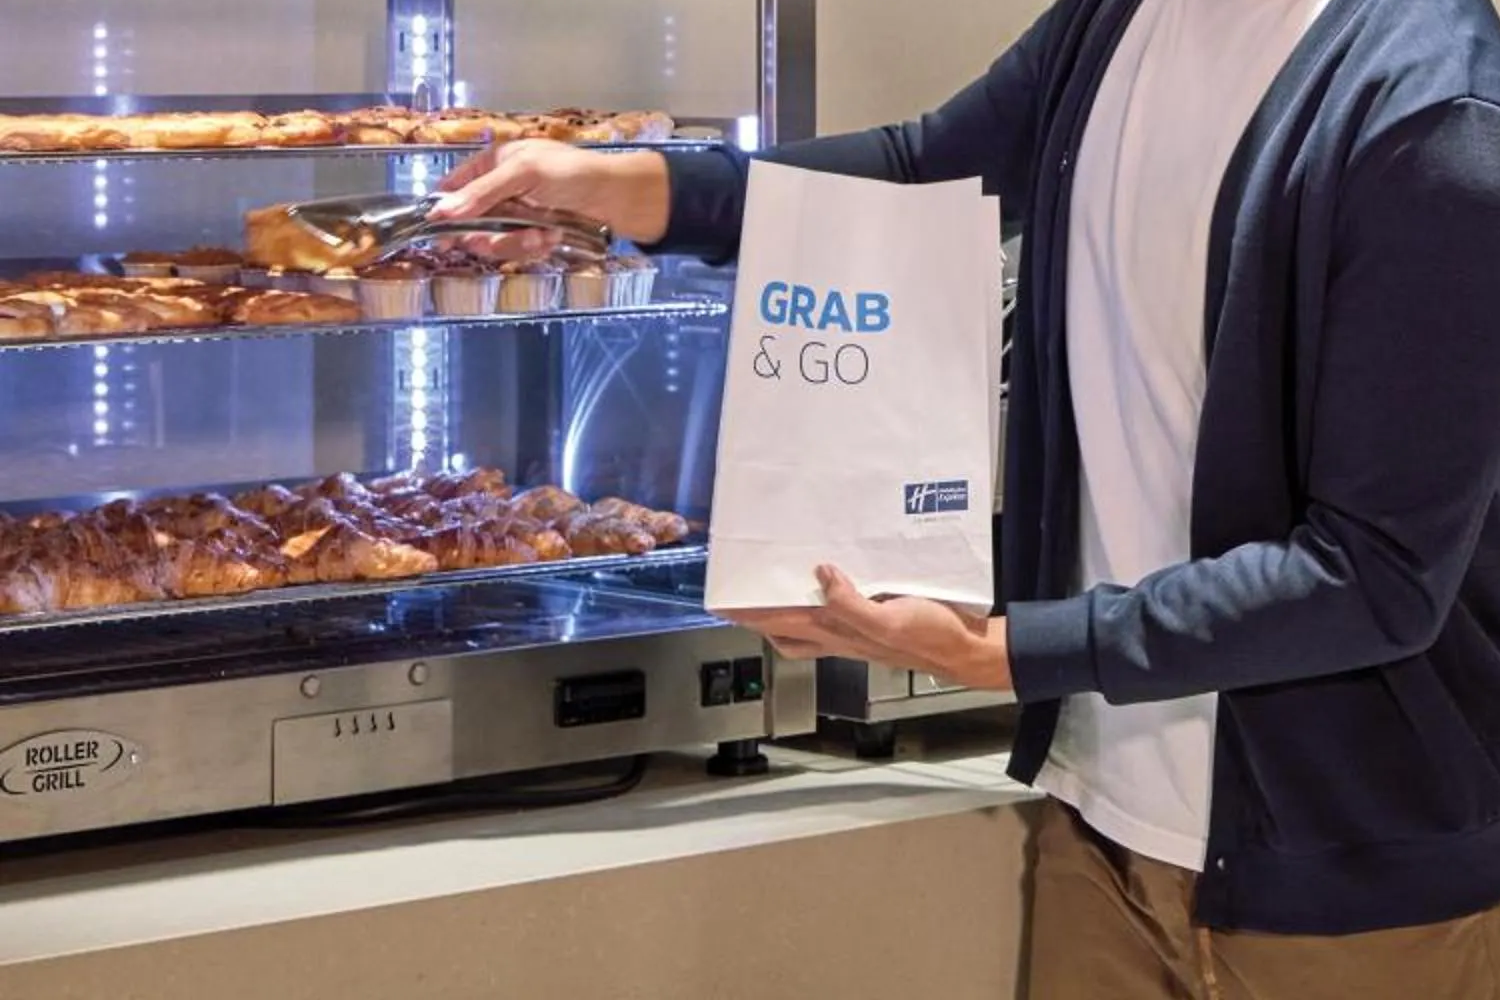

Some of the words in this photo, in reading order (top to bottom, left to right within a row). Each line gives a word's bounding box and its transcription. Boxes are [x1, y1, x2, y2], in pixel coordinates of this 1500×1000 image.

[760, 280, 891, 333] GRAB
[752, 335, 782, 381] &
[799, 342, 870, 385] GO
[26, 741, 99, 766] ROLLER
[32, 770, 85, 793] GRILL
